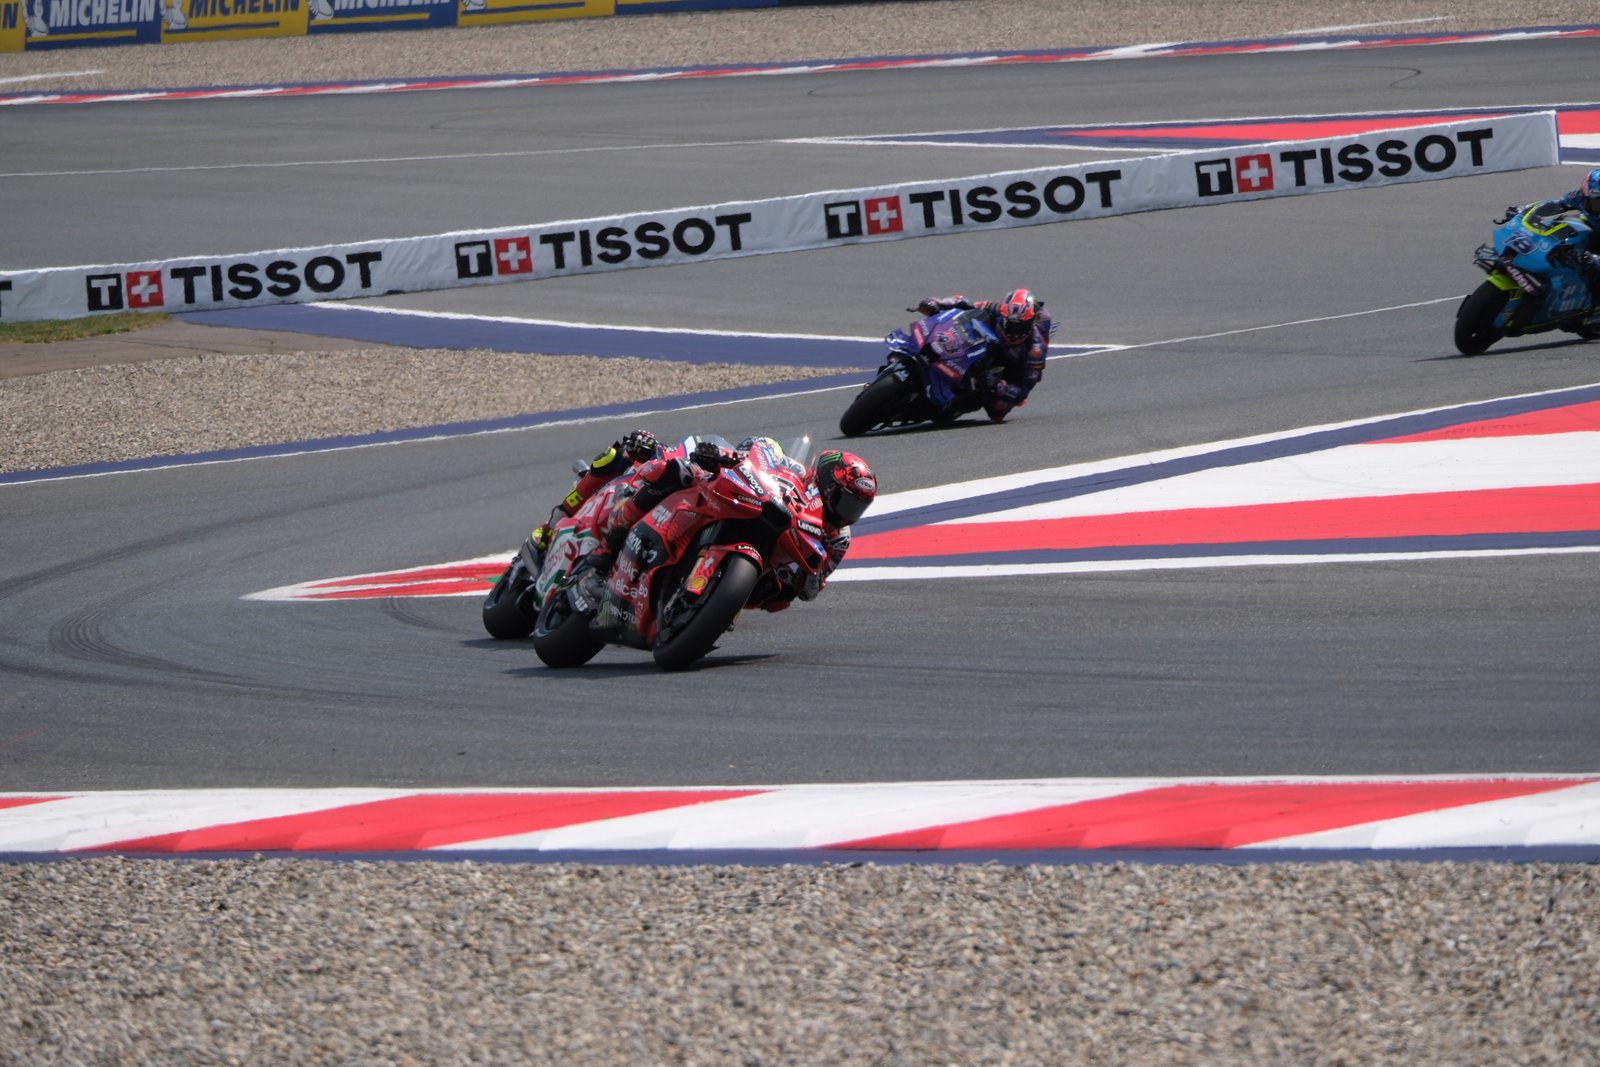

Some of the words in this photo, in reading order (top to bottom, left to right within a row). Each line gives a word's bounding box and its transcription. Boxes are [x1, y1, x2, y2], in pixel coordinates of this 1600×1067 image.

[49, 0, 155, 28] MICHELIN
[1280, 127, 1493, 187] TISSOT
[909, 169, 1122, 228] TISSOT
[540, 213, 751, 269] TISSOT
[170, 251, 382, 304] TISSOT
[738, 464, 765, 496] Lenovo
[797, 519, 822, 537] Lenovo
